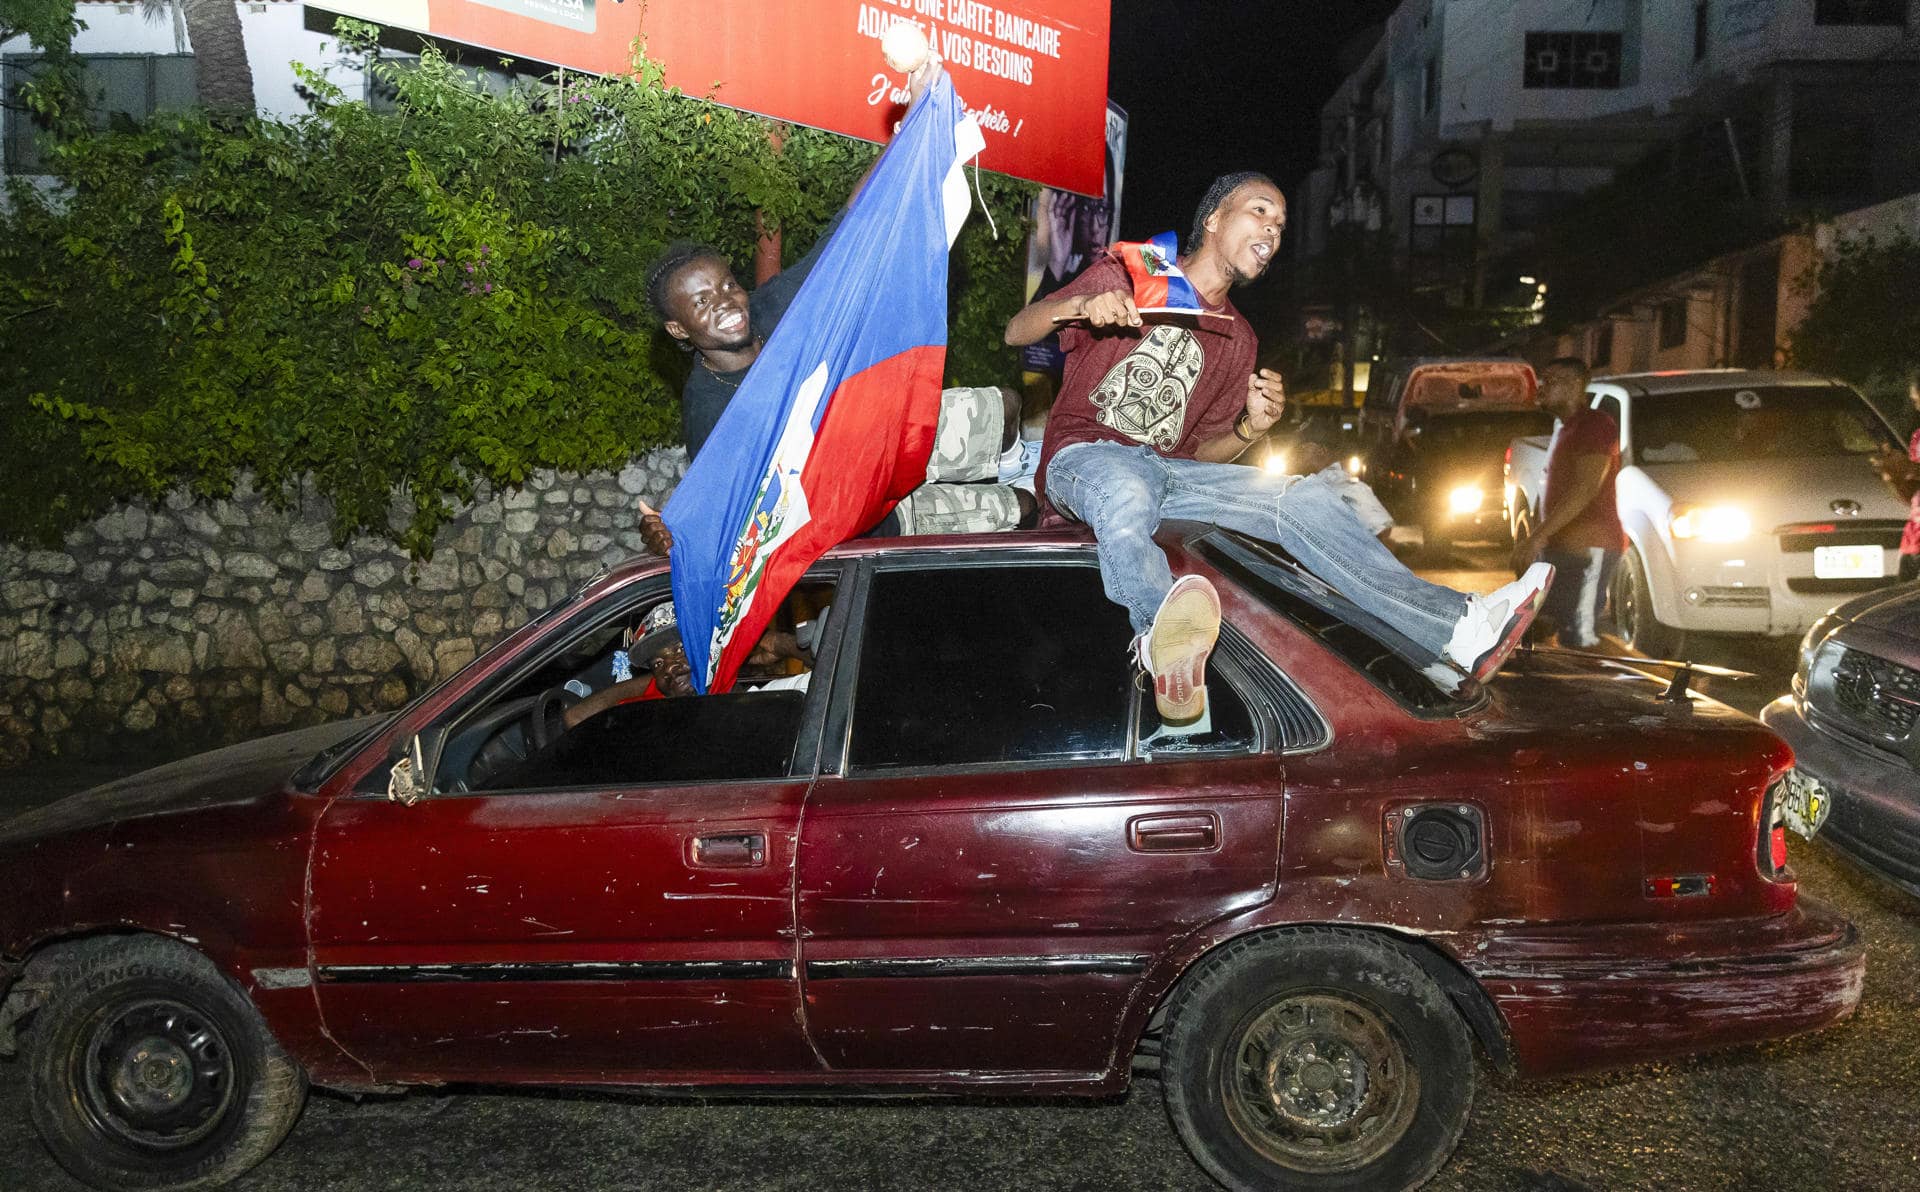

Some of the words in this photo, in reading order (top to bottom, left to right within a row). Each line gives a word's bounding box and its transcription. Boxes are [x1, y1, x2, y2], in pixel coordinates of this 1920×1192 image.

[929, 20, 939, 51] À
[942, 30, 972, 67] VOS
[974, 40, 1033, 86] BESOINS
[949, 0, 993, 37] CARTE
[995, 10, 1062, 59] BANCAIRE
